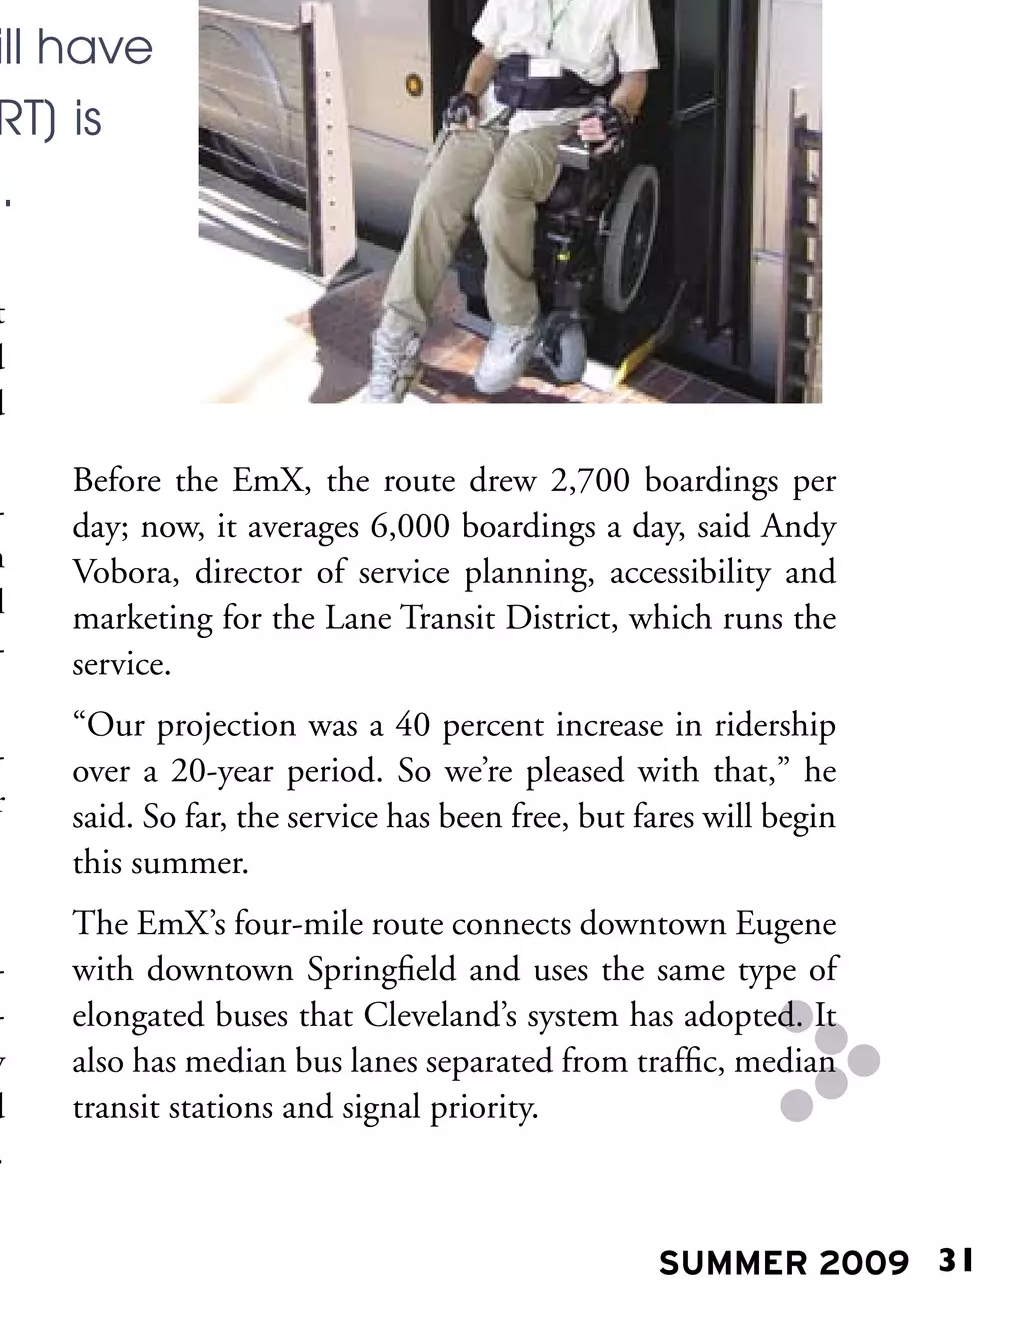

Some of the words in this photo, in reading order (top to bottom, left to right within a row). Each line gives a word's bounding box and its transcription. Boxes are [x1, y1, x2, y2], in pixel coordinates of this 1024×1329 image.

[38, 27, 153, 65] have
[76, 99, 102, 136] is
[73, 464, 161, 493] Before
[175, 465, 219, 492] the
[232, 466, 311, 496] EmX,
[326, 465, 370, 492] the
[383, 473, 456, 493] route
[469, 465, 538, 493] drew
[550, 467, 630, 496] 2,700
[644, 465, 779, 502] boardings
[792, 475, 837, 501] per
[73, 602, 214, 639] marketing
[222, 602, 263, 630] for
[272, 602, 315, 630] the
[325, 604, 392, 630] Lane
[399, 603, 496, 630] Transit
[506, 604, 618, 634] District,
[628, 602, 713, 630] which
[723, 613, 783, 630] runs
[793, 602, 837, 630] the
[72, 650, 171, 676] service.
[73, 847, 122, 875] this
[131, 857, 248, 875] summer.
[71, 908, 129, 936] The
[234, 908, 364, 936] four-mile
[372, 917, 444, 936] route
[452, 917, 571, 936] connects
[580, 908, 727, 936] downtown
[735, 909, 837, 945] Eugene
[71, 954, 135, 981] with
[147, 953, 294, 982] downtown
[307, 953, 457, 991] Springfield
[469, 954, 521, 982] and
[533, 964, 588, 982] uses
[601, 954, 645, 982] the
[657, 964, 725, 982] same
[738, 963, 797, 990] type
[809, 953, 842, 982] of
[72, 1093, 160, 1119] transit
[169, 1093, 273, 1119] stations
[282, 1091, 334, 1119] and
[342, 1091, 421, 1128] signal
[430, 1093, 538, 1128] priority.
[659, 1249, 807, 1276] SUMMER
[819, 1249, 909, 1276] 2009
[939, 1247, 972, 1273] 31
